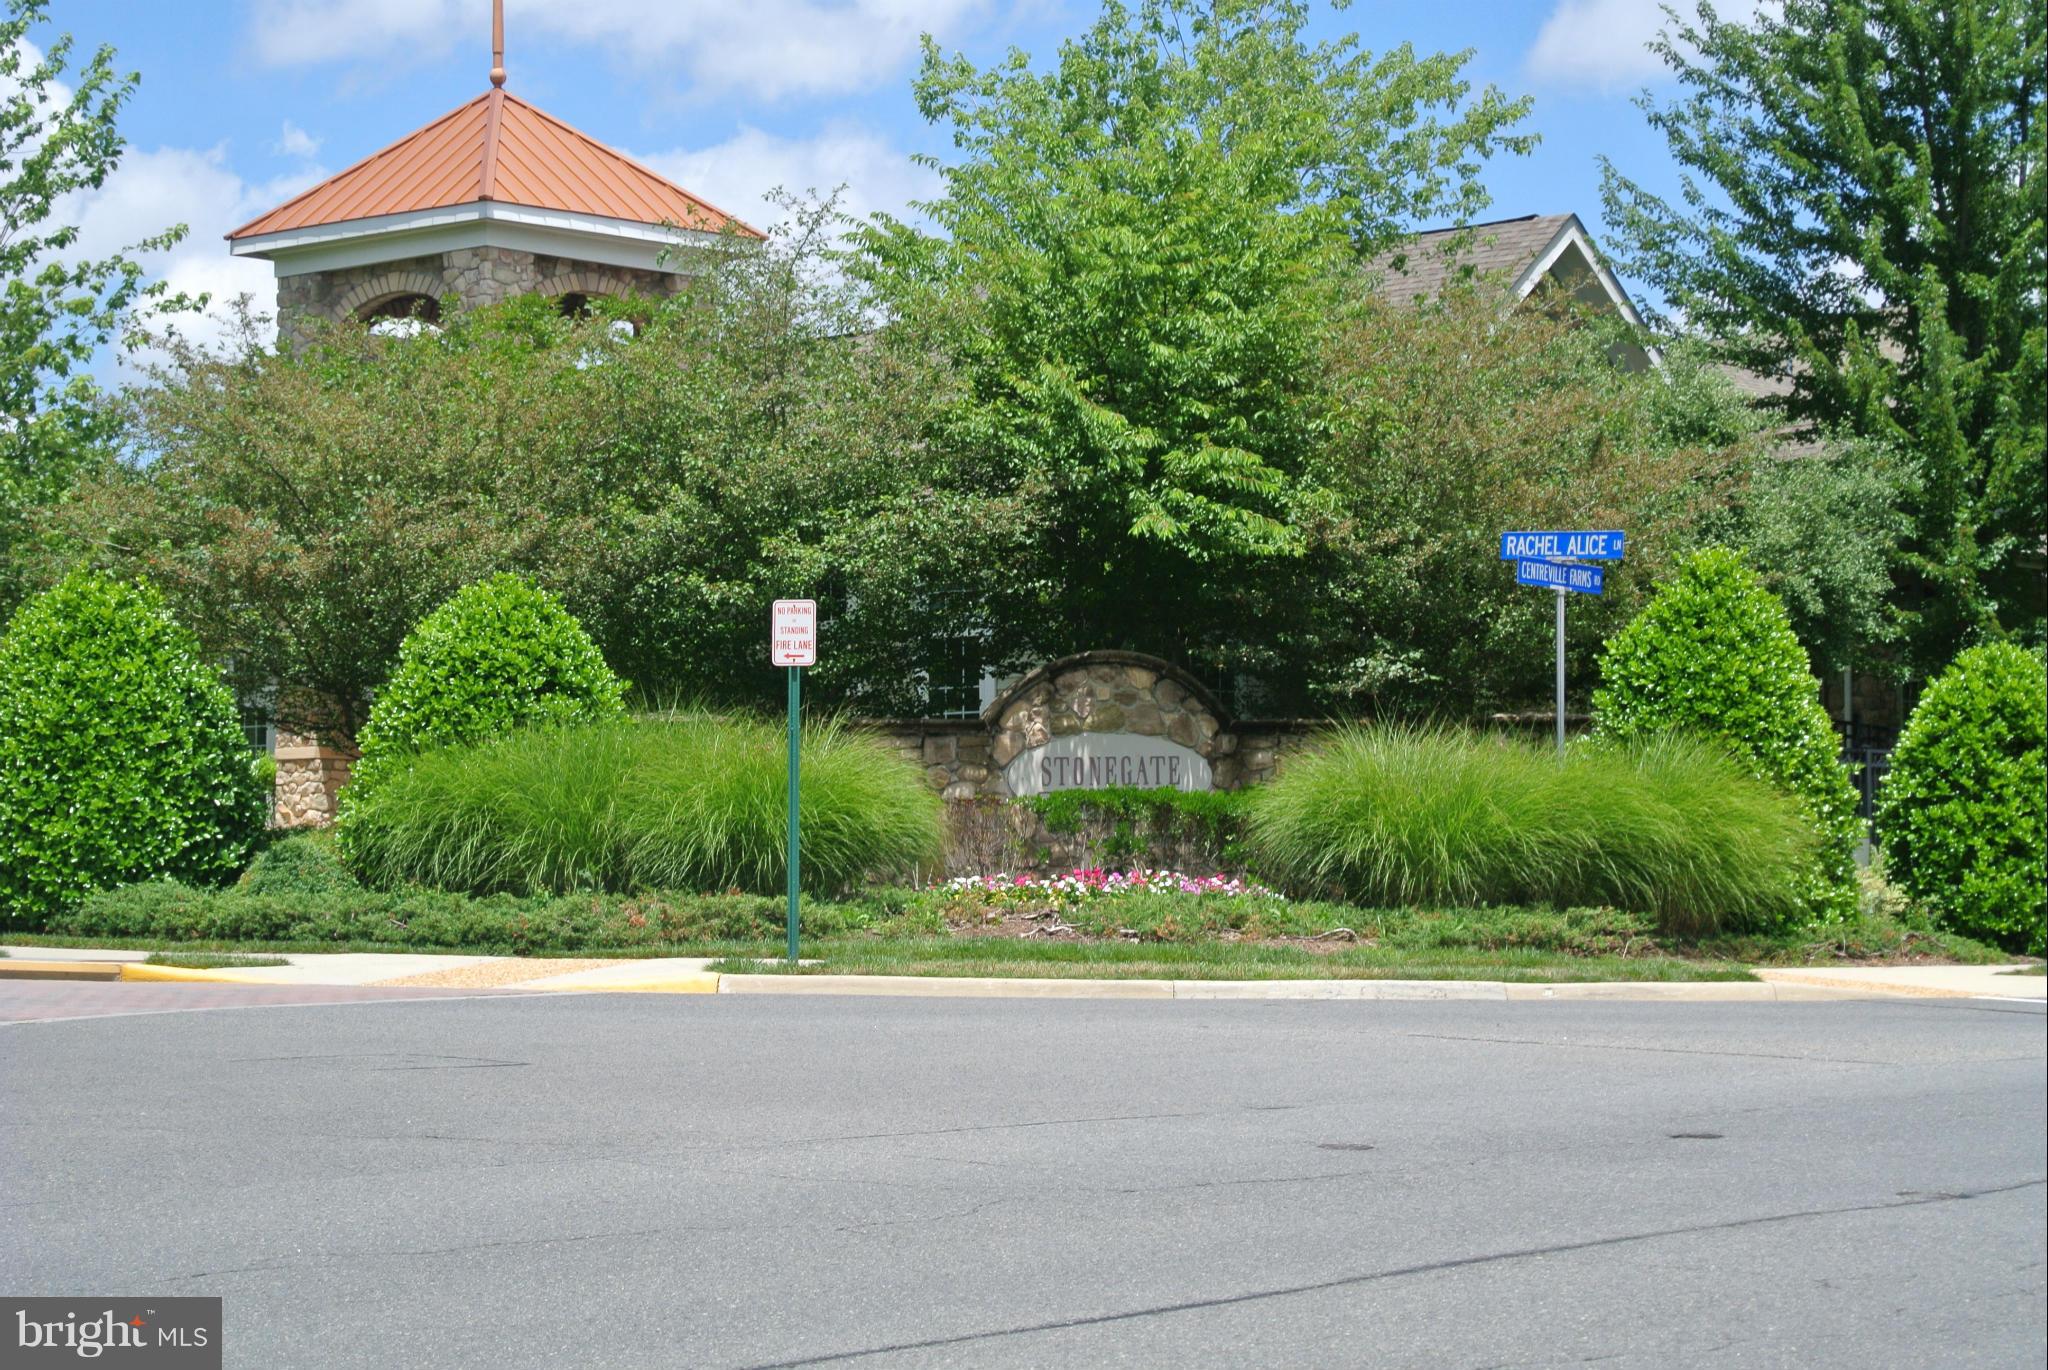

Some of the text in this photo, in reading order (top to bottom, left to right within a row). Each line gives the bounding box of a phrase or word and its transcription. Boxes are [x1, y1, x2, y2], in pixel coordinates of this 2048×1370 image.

[1506, 535, 1622, 556] RACHEL ALICE LN
[1521, 561, 1567, 584] CENTREVILLE
[1569, 568, 1591, 588] FARMS
[777, 607, 811, 615] NO PARKING
[780, 626, 808, 634] STANDING
[776, 640, 812, 650] FIRE LANE
[1041, 756, 1180, 787] STONEGATE
